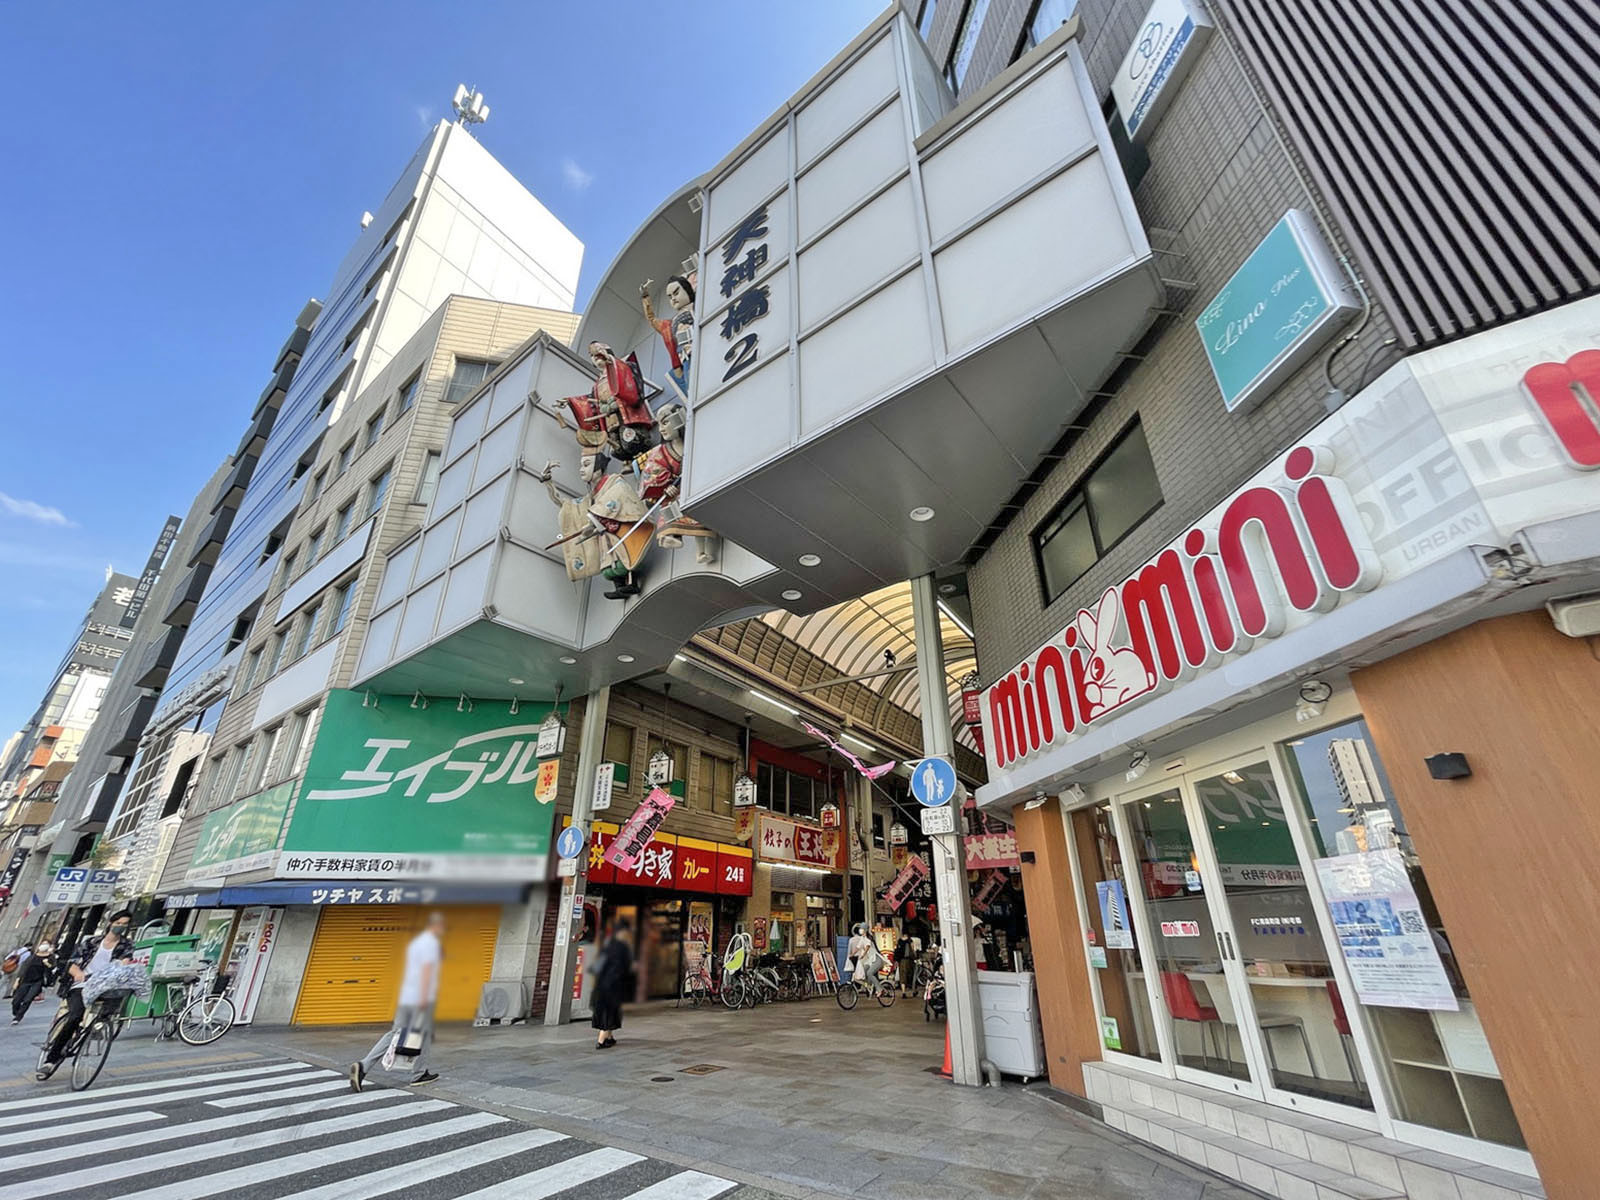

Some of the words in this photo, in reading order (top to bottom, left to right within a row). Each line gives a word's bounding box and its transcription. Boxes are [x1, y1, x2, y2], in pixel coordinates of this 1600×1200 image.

[1402, 511, 1482, 563] URBAN
[989, 624, 1095, 770] mini
[1122, 446, 1361, 682] mini
[306, 723, 541, 803] エイブル
[60, 870, 85, 881] JR
[682, 857, 710, 881] カレー
[311, 887, 364, 904] ツチヤ
[258, 922, 275, 953] DyDo
